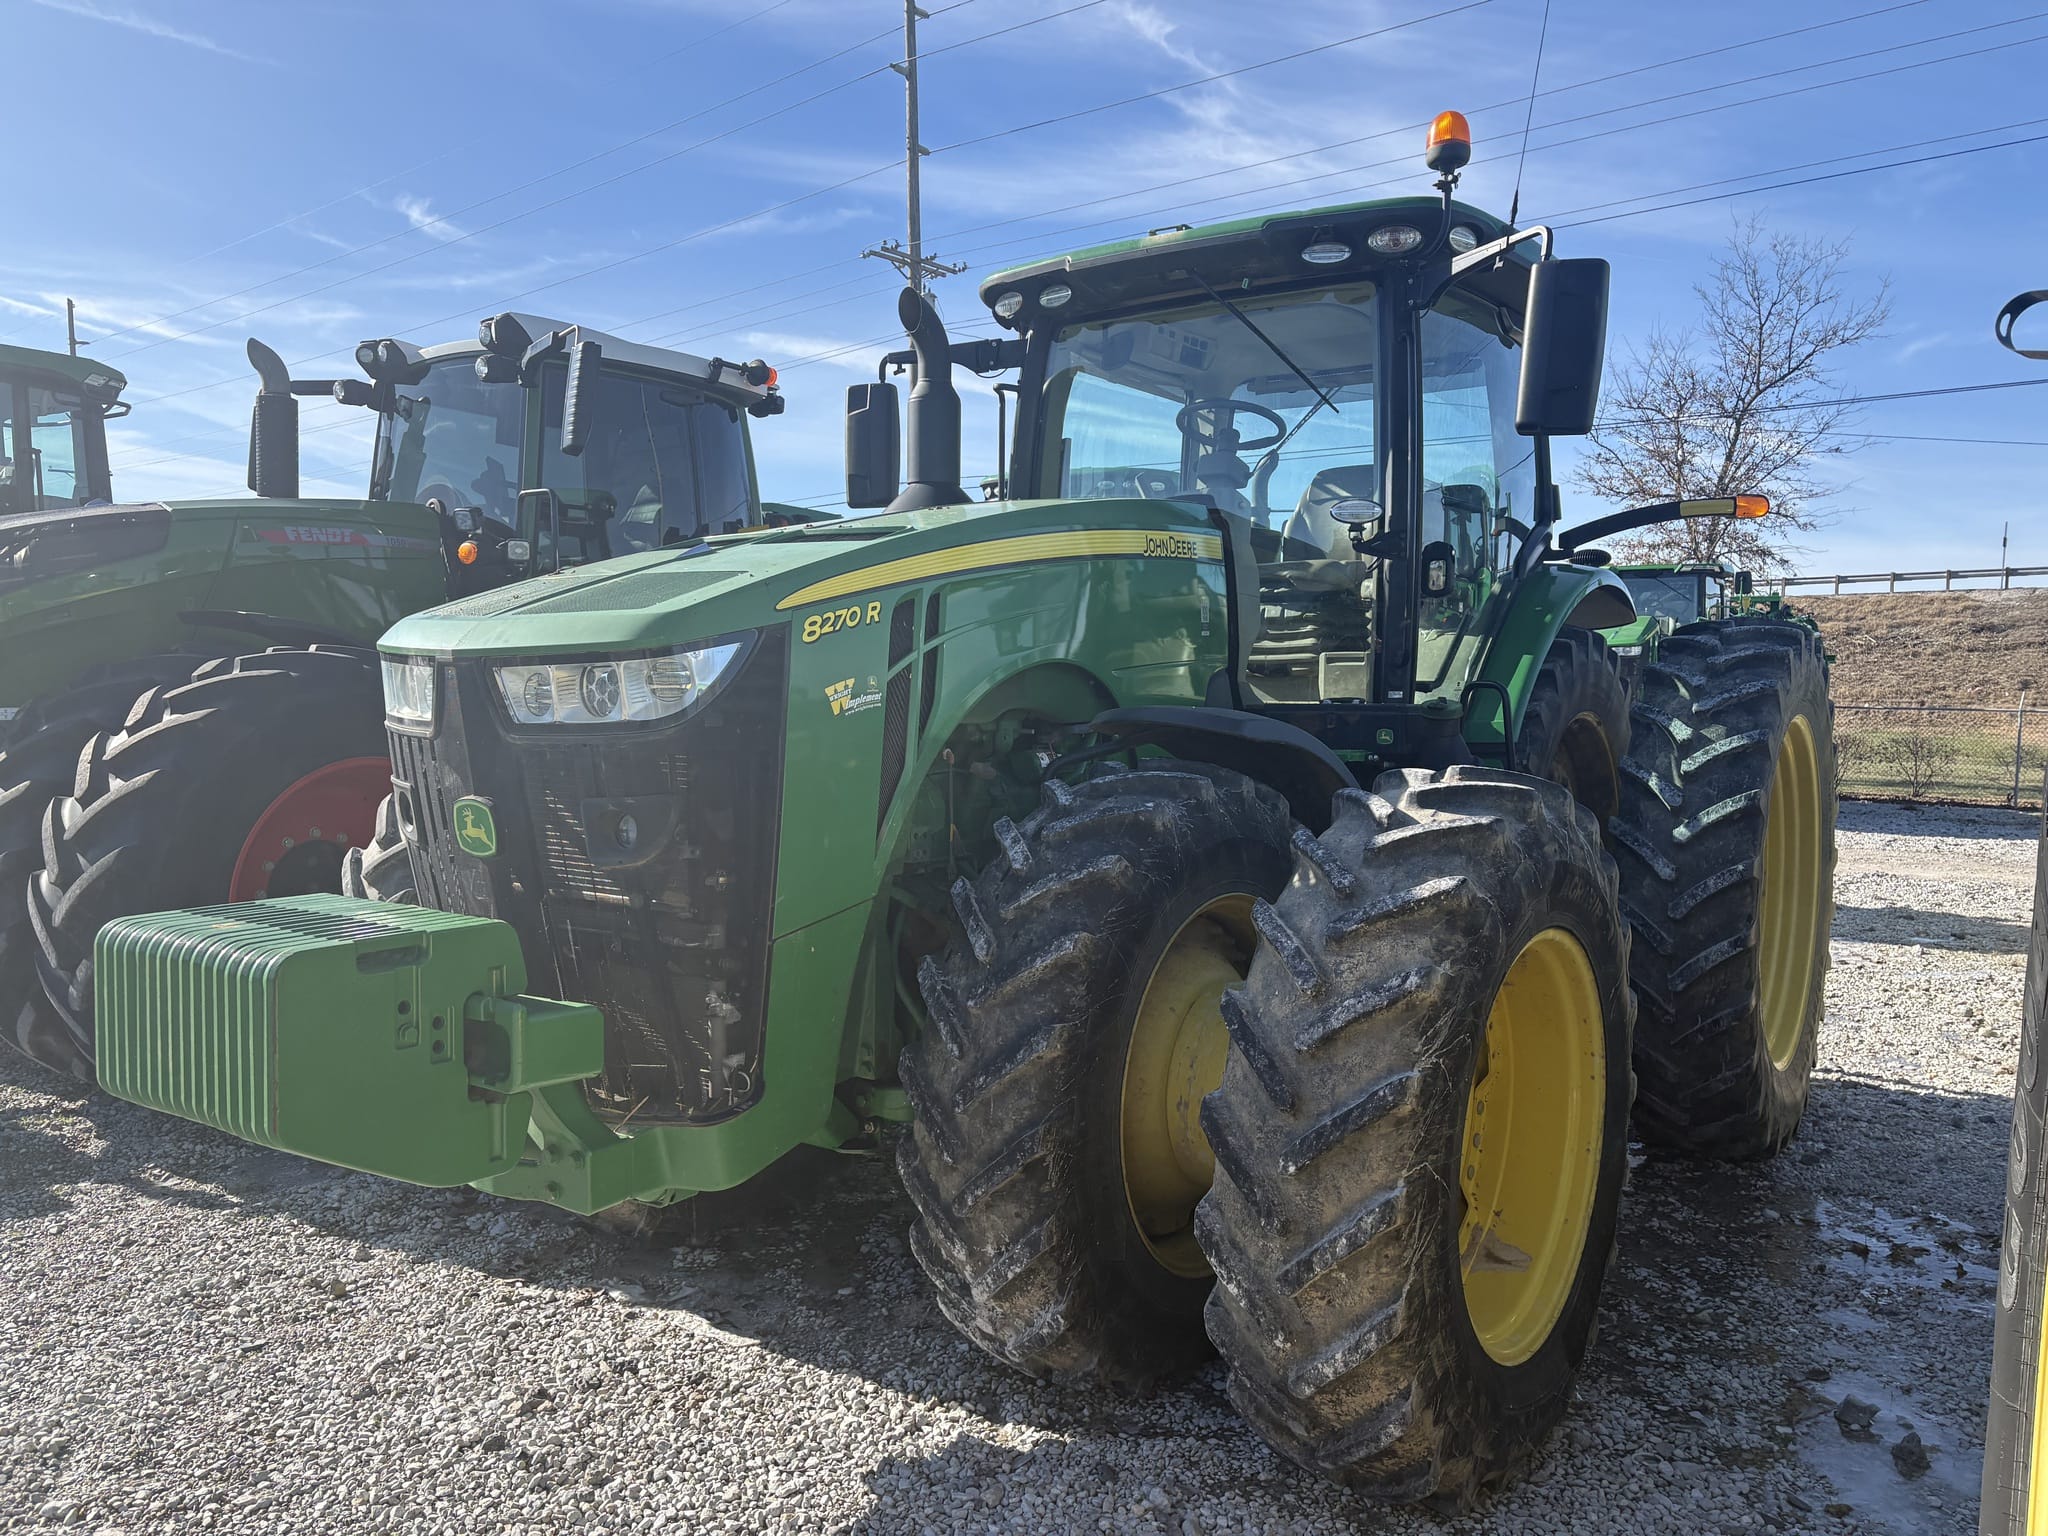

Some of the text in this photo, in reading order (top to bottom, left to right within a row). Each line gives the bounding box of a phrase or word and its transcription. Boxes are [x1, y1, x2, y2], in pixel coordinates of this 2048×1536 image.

[284, 526, 353, 544] FENDT
[802, 600, 881, 644] 8270 R
